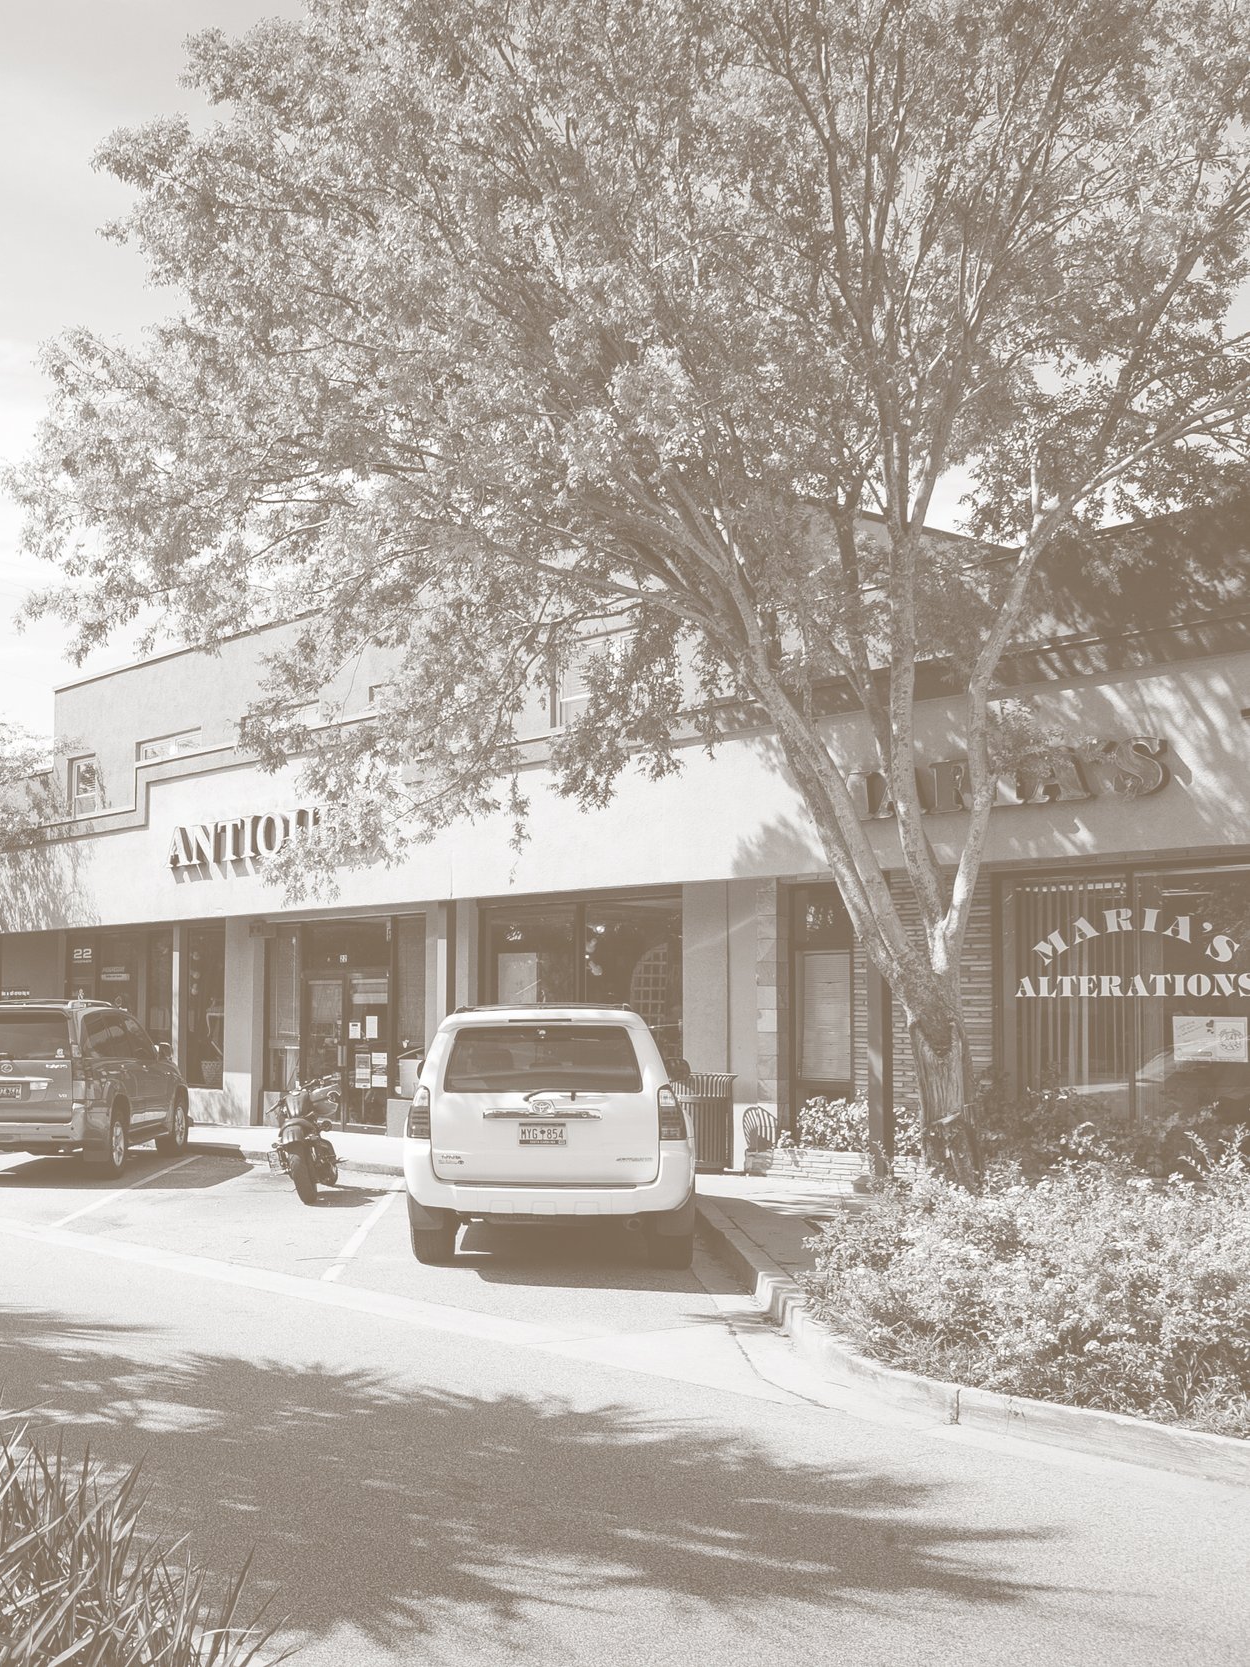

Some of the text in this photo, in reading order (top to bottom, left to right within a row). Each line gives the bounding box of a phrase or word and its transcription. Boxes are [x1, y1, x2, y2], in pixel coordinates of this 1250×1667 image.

[166, 802, 344, 868] ANTIQU
[1031, 907, 1241, 967] MARIA'S
[73, 948, 92, 959] 22
[1014, 972, 1250, 999] ALTERATIONS
[520, 1128, 564, 1140] MYG 854
